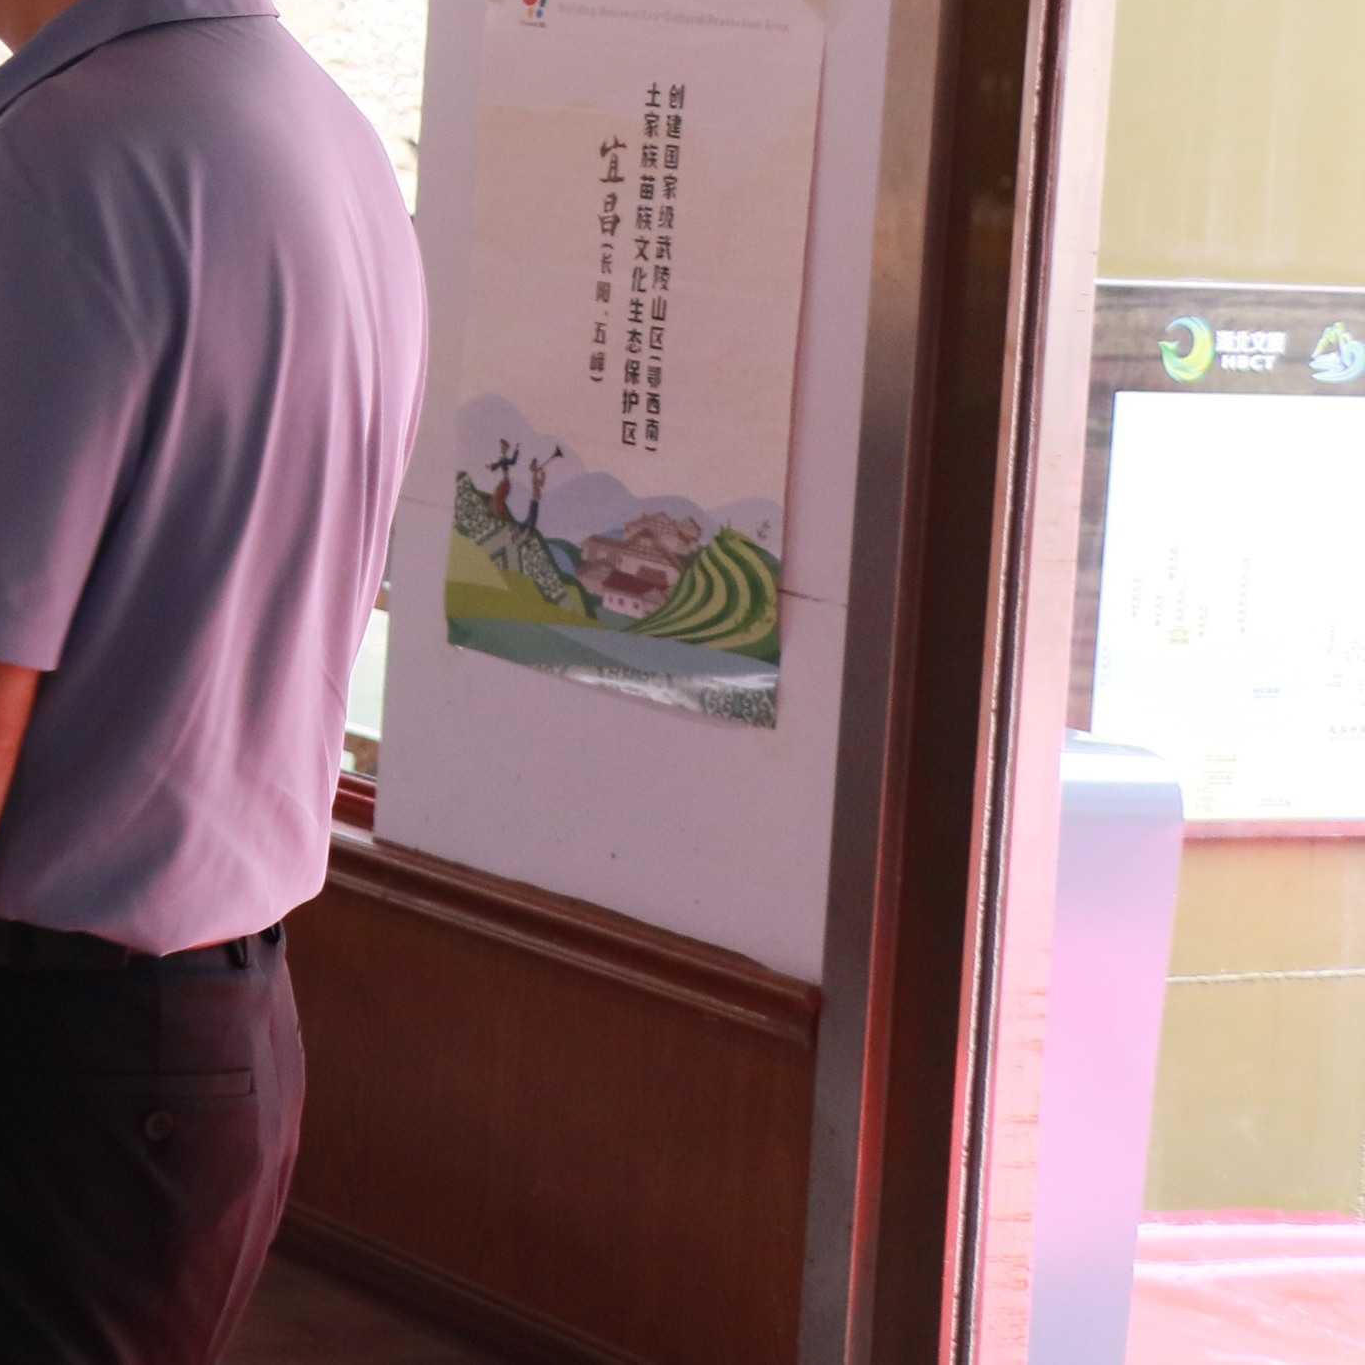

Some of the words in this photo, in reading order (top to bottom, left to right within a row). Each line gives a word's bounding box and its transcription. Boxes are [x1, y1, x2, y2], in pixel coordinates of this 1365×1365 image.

[621, 82, 661, 446] 土家族苗族文化生态保护区
